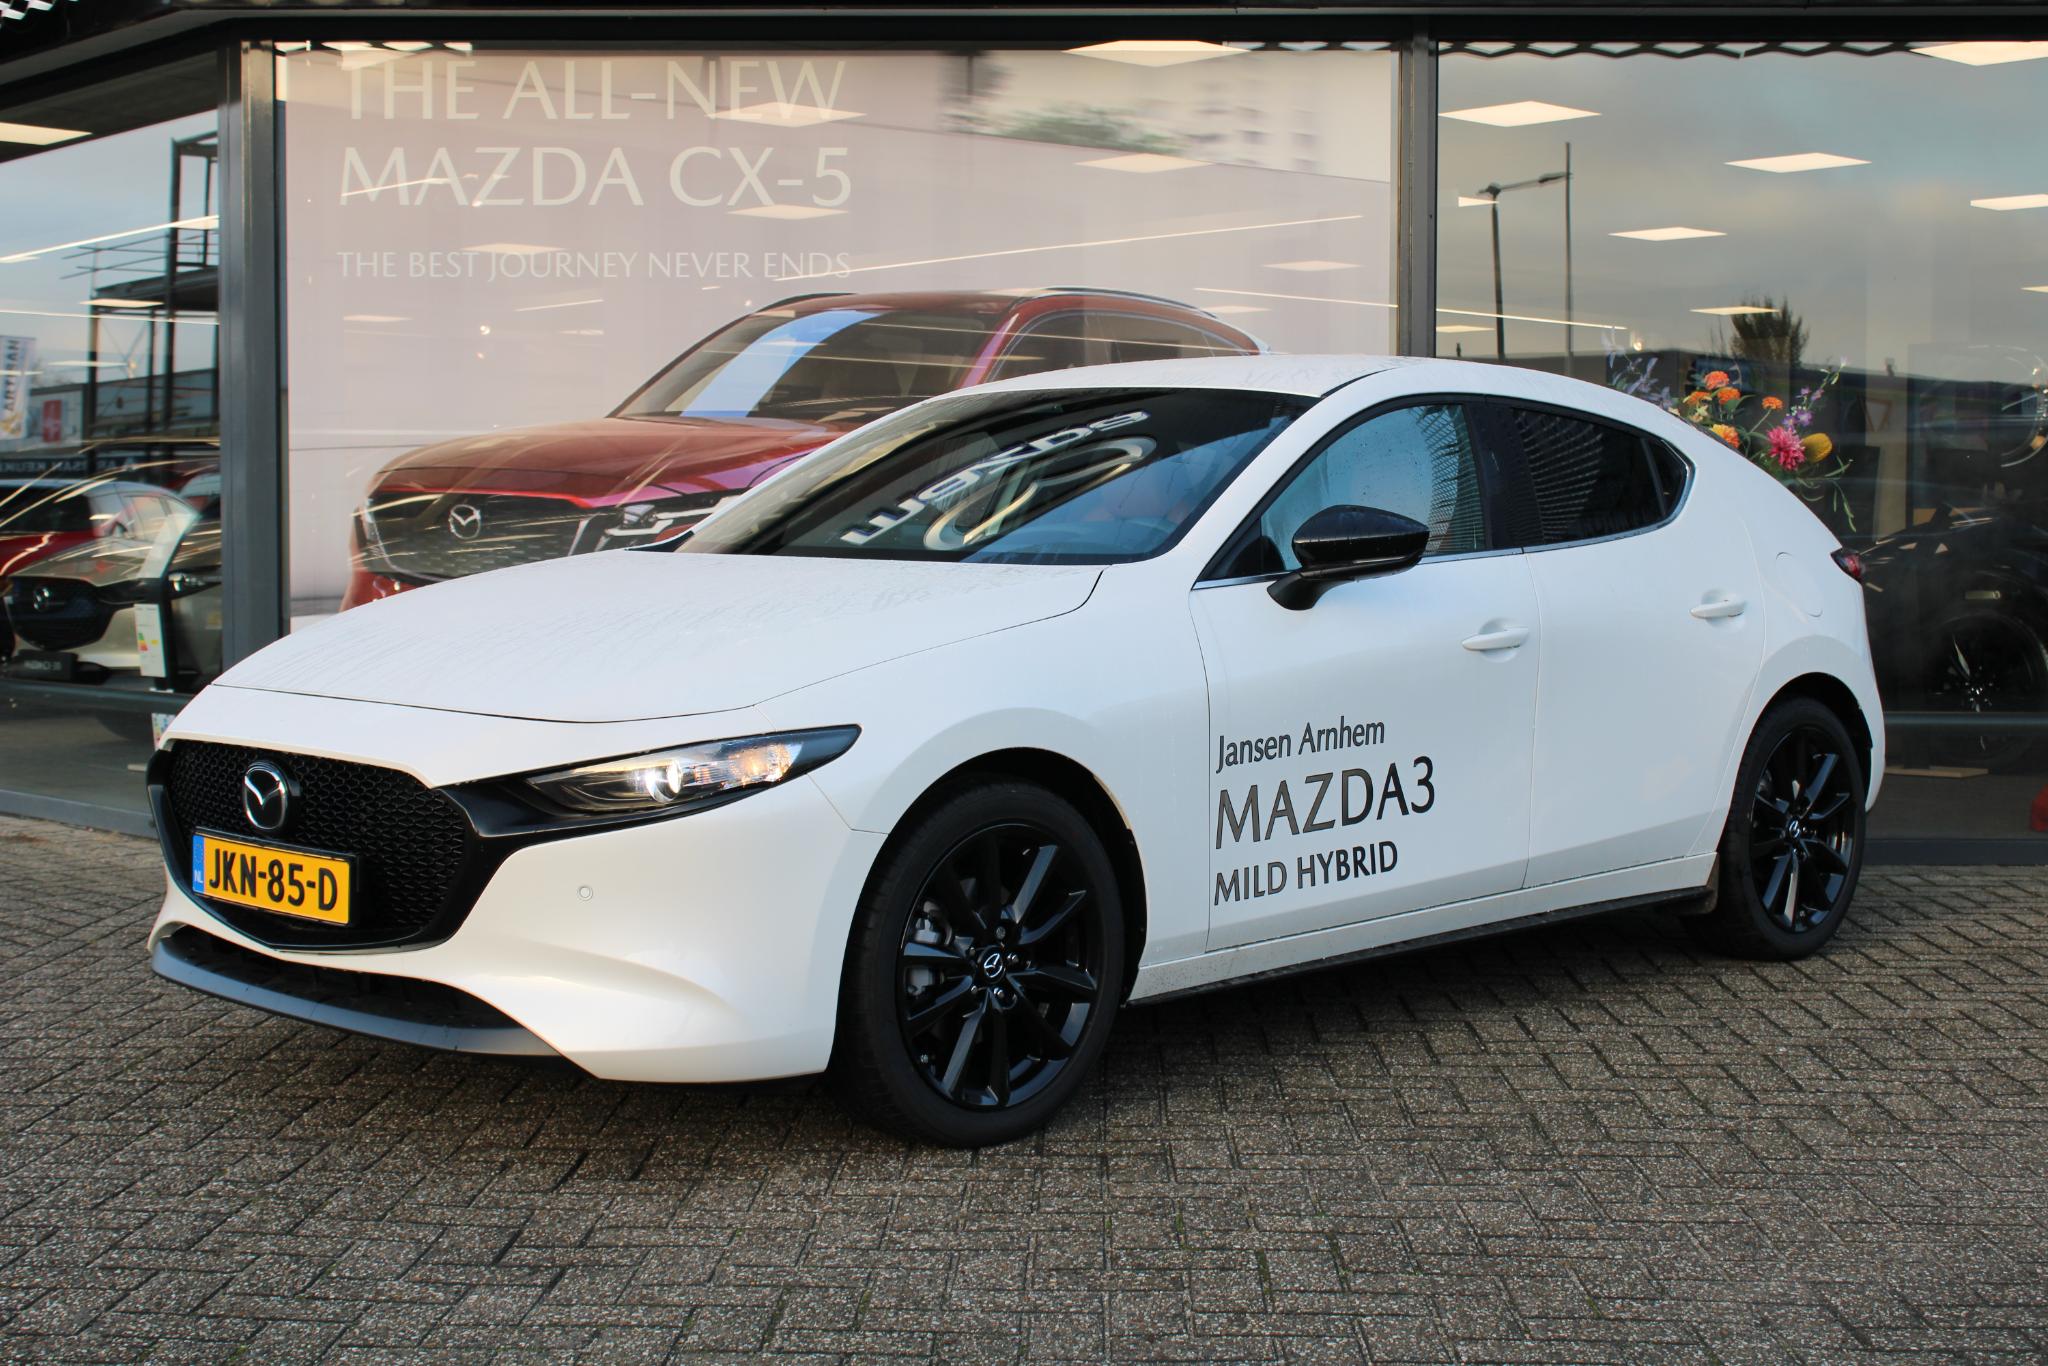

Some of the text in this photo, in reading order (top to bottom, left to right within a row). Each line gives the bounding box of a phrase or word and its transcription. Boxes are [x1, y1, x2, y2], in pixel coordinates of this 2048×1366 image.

[342, 60, 847, 120] THE ALL-NEW
[338, 146, 852, 207] MAZDA CX-5
[336, 251, 852, 282] THE BEST JOURNEY NEVER ENDS
[1215, 715, 1386, 774] Jansen Arnhem
[1215, 755, 1435, 850] MAZDA3
[193, 869, 204, 884] NL
[208, 847, 339, 912] JKN-85-D
[1213, 840, 1398, 906] MILD HYBRID
